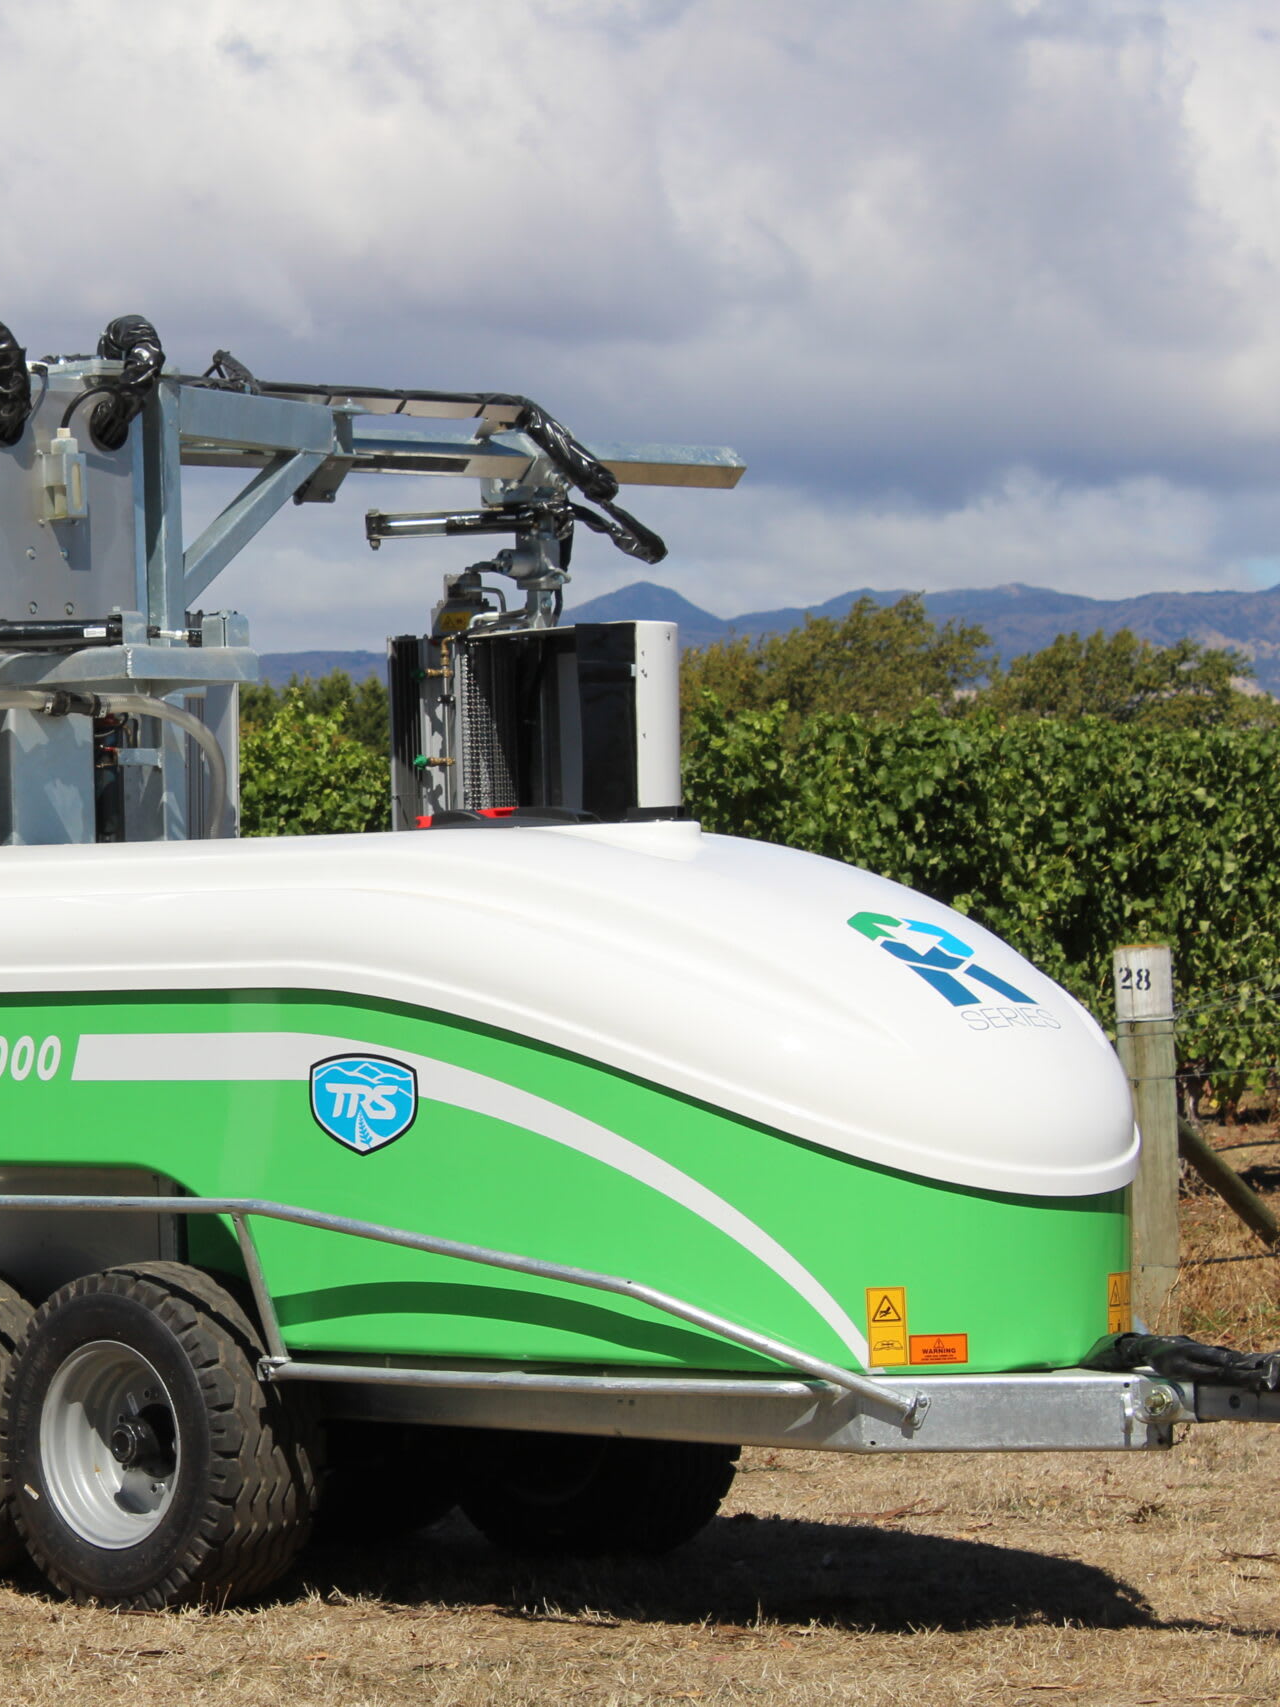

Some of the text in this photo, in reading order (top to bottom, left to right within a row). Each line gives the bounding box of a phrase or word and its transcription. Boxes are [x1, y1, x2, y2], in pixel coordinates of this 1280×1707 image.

[1118, 966, 1151, 991] 28
[960, 1006, 1062, 1031] SERIES
[325, 1082, 399, 1120] TRS
[921, 1347, 957, 1355] WARNING
